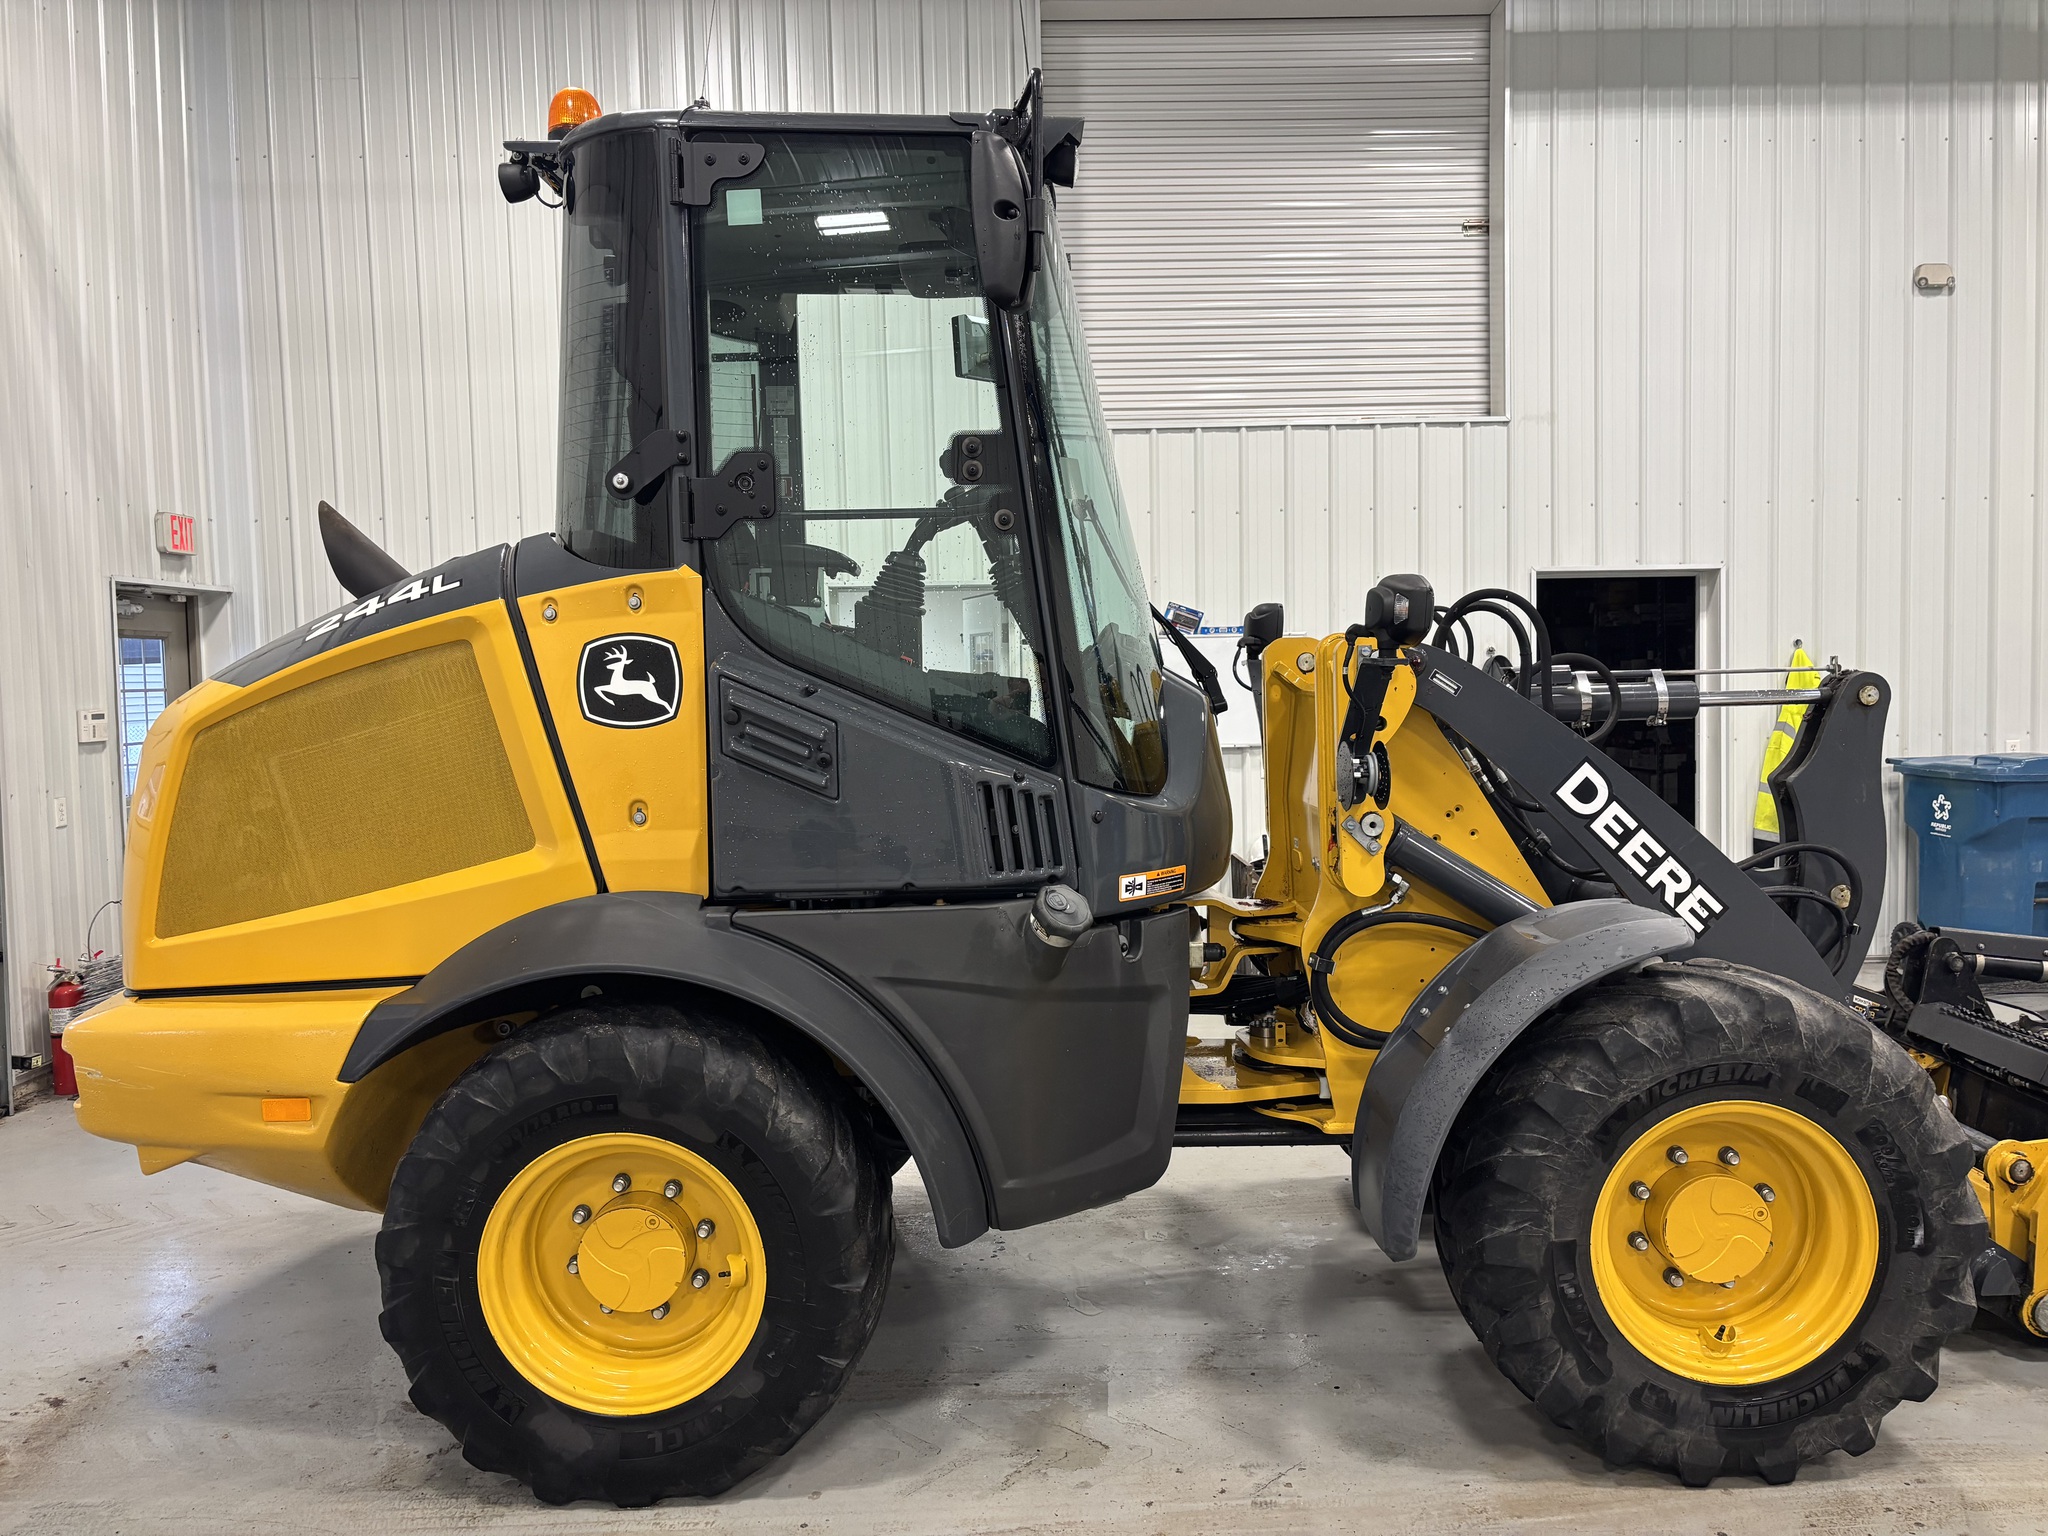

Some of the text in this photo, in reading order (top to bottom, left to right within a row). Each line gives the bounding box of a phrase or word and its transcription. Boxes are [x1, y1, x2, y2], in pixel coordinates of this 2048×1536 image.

[170, 514, 194, 553] EXIT
[305, 574, 461, 642] 244L
[1555, 761, 1724, 934] DEERE
[1709, 1366, 1851, 1428] MICHELIN
